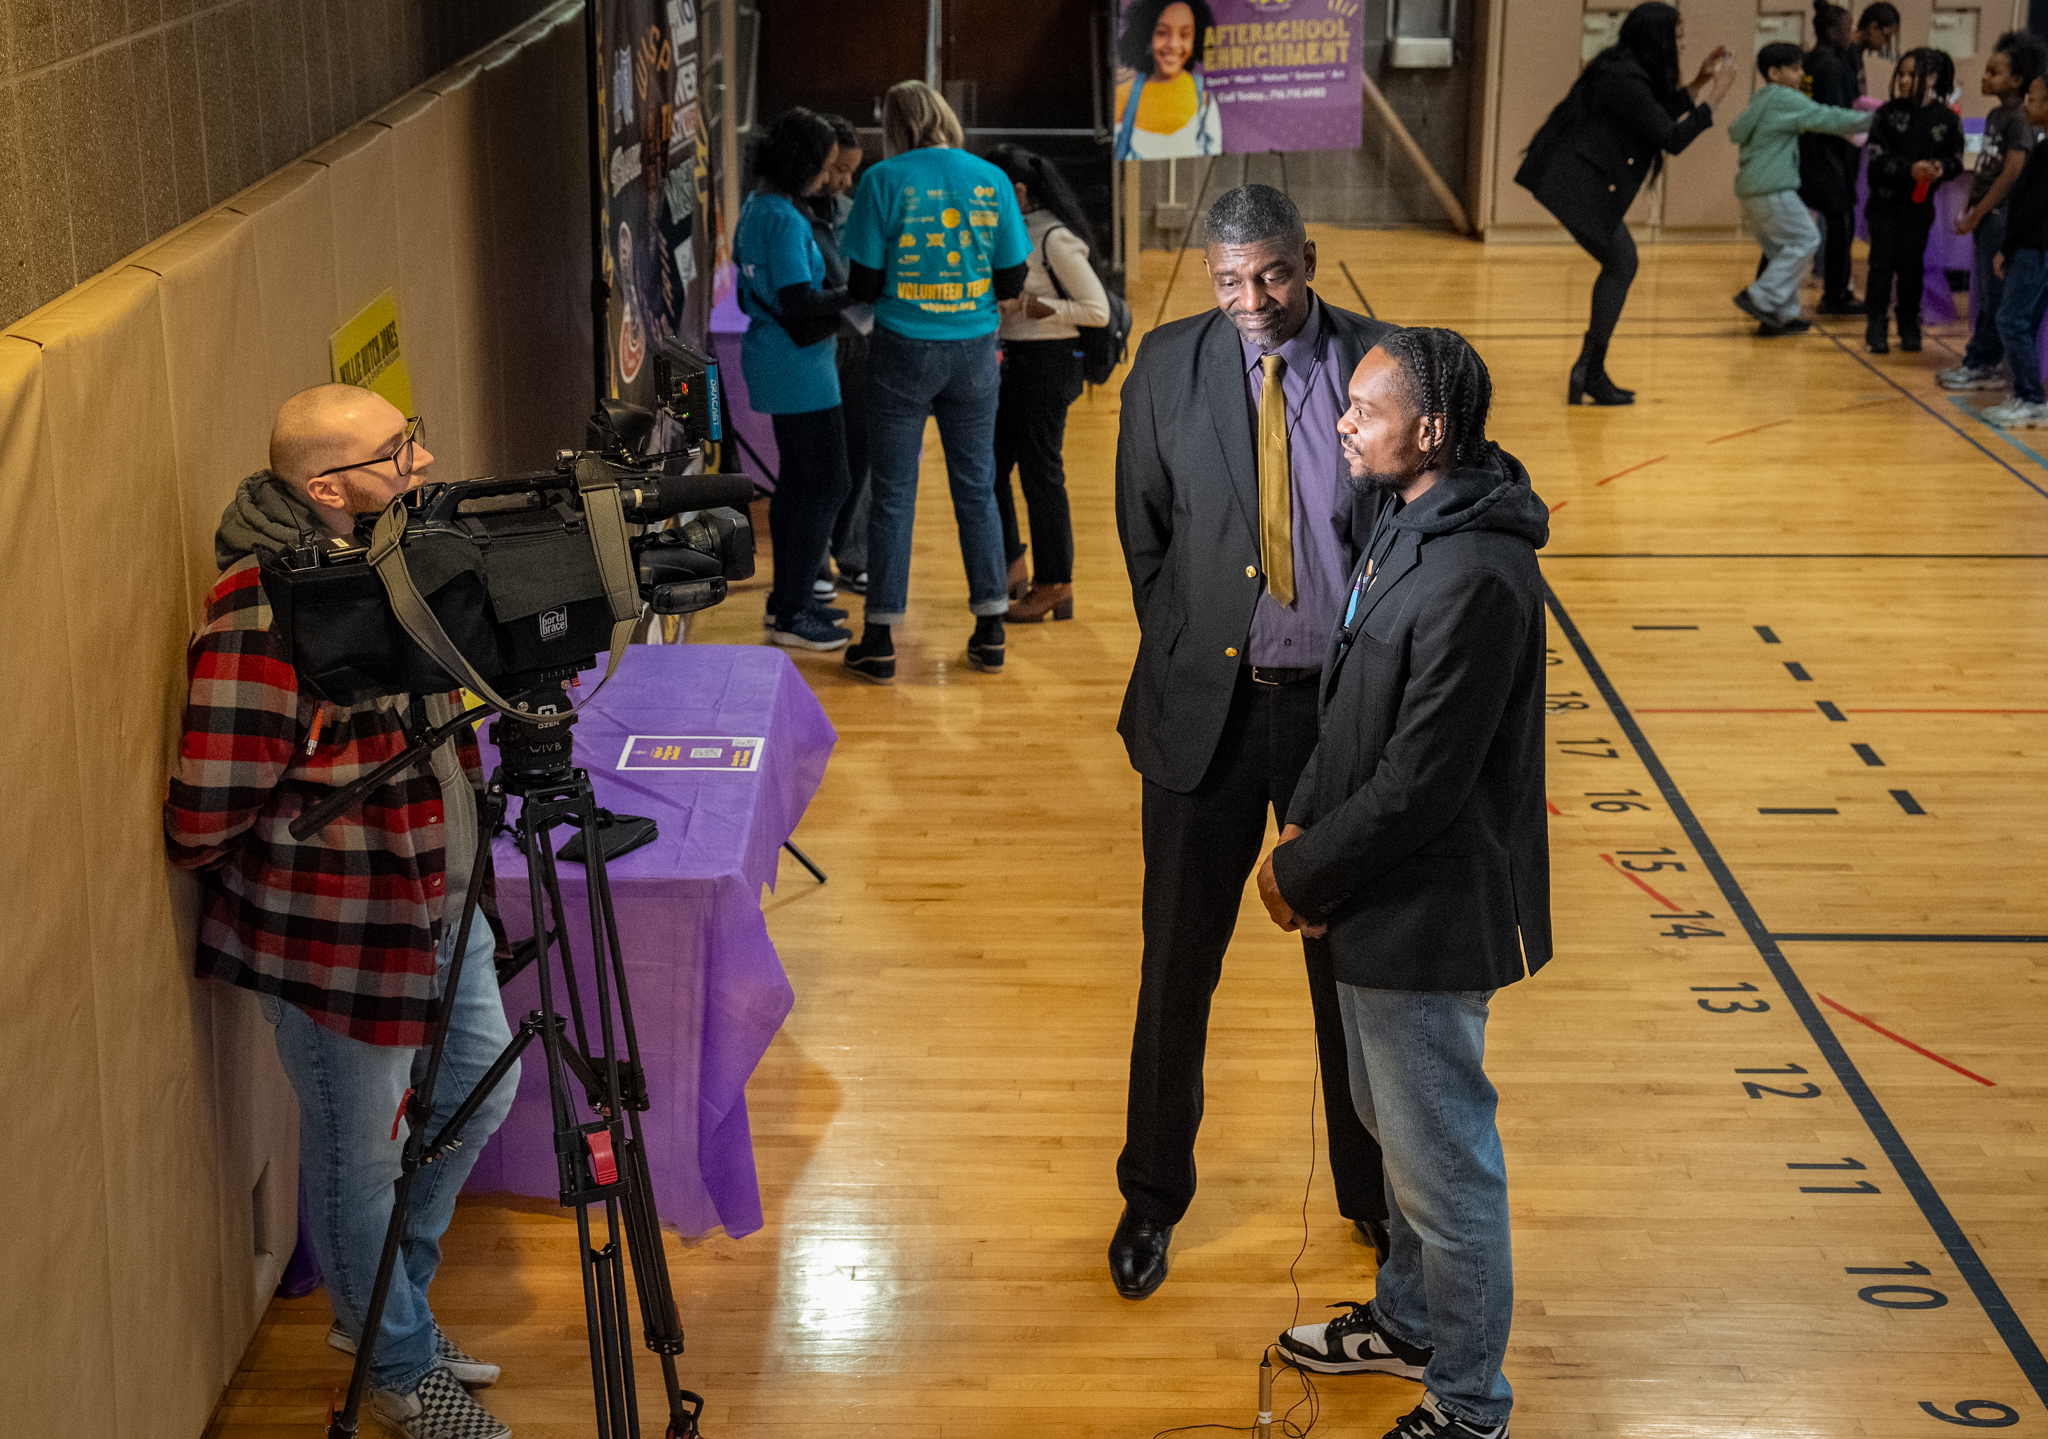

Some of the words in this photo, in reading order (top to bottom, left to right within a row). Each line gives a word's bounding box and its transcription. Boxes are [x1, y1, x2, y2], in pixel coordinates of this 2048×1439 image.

[1203, 17, 1350, 48] AFTERSCHOOL
[1203, 40, 1350, 72] ENRICHMENT
[897, 282, 964, 301] VOLUNTEER
[710, 378, 720, 427] DRACAST
[542, 612, 565, 627] porta
[543, 620, 565, 635] brace
[1546, 691, 1590, 710] 18
[538, 720, 560, 729] OZEN
[1556, 737, 1620, 759] 17
[1584, 789, 1652, 813] 16
[1616, 847, 1687, 873] 15
[1649, 909, 1727, 939] 14
[1690, 981, 1771, 1014] 13
[1733, 1062, 1822, 1099] 12
[1786, 1157, 1882, 1194] 11
[1844, 1260, 1949, 1310] 10
[1917, 1399, 2020, 1428] 9
